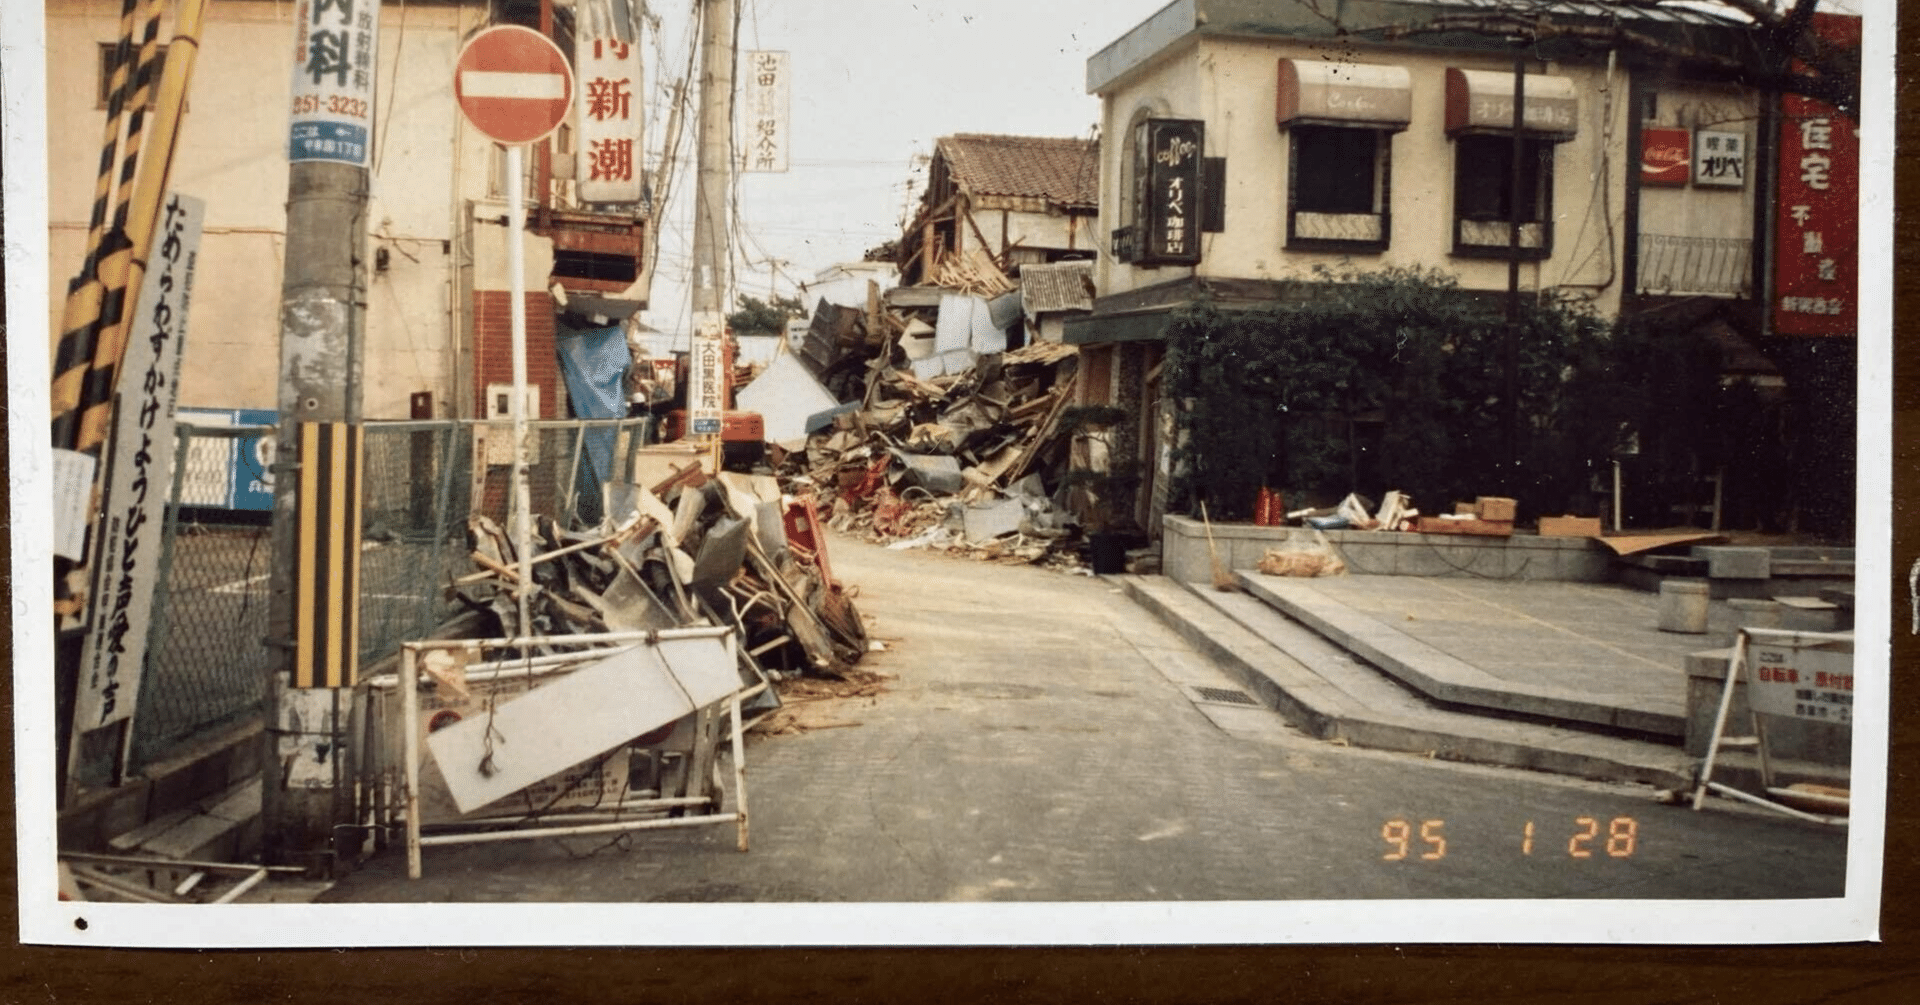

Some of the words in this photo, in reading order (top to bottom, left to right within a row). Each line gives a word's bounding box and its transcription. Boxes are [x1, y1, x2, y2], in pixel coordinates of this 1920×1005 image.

[1701, 155, 1742, 179] オリベ
[1800, 118, 1832, 190] 住宅
